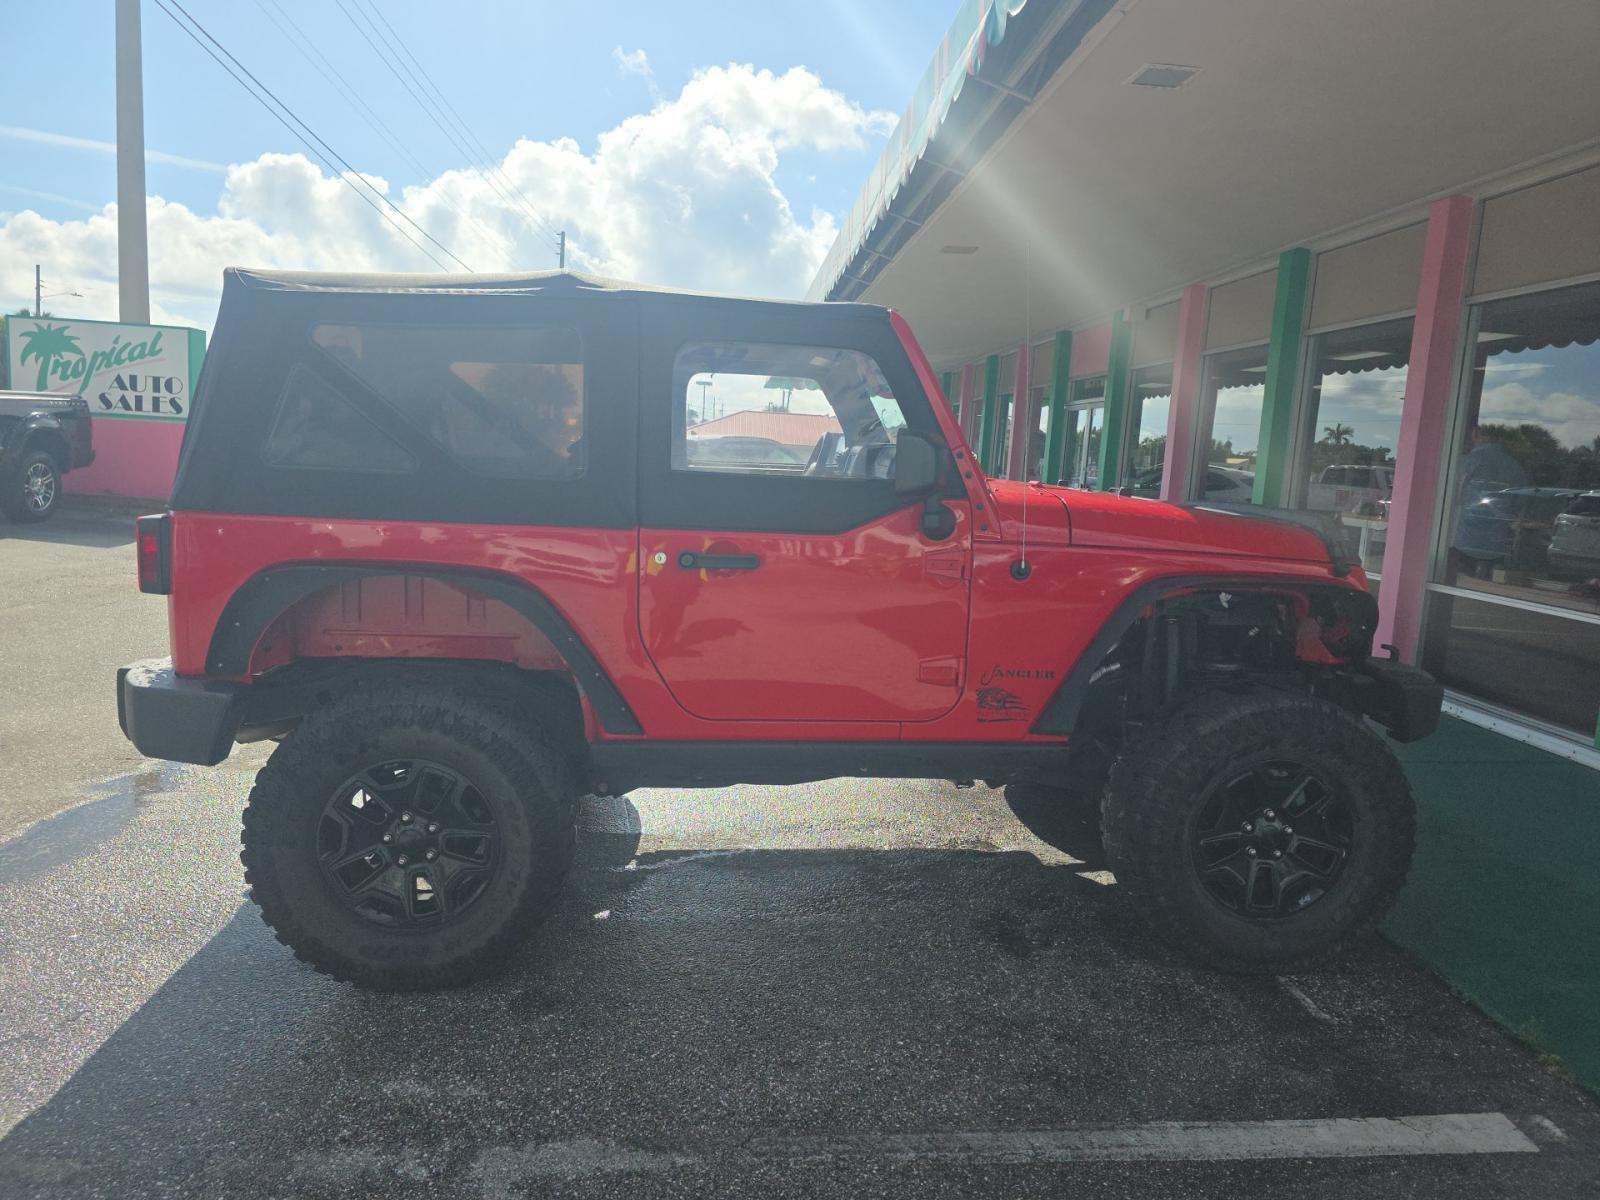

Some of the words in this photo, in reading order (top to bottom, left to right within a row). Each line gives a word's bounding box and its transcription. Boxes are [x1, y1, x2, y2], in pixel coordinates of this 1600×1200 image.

[36, 331, 163, 394] Tropical
[108, 374, 183, 394] AUTO
[98, 392, 183, 415] SALES
